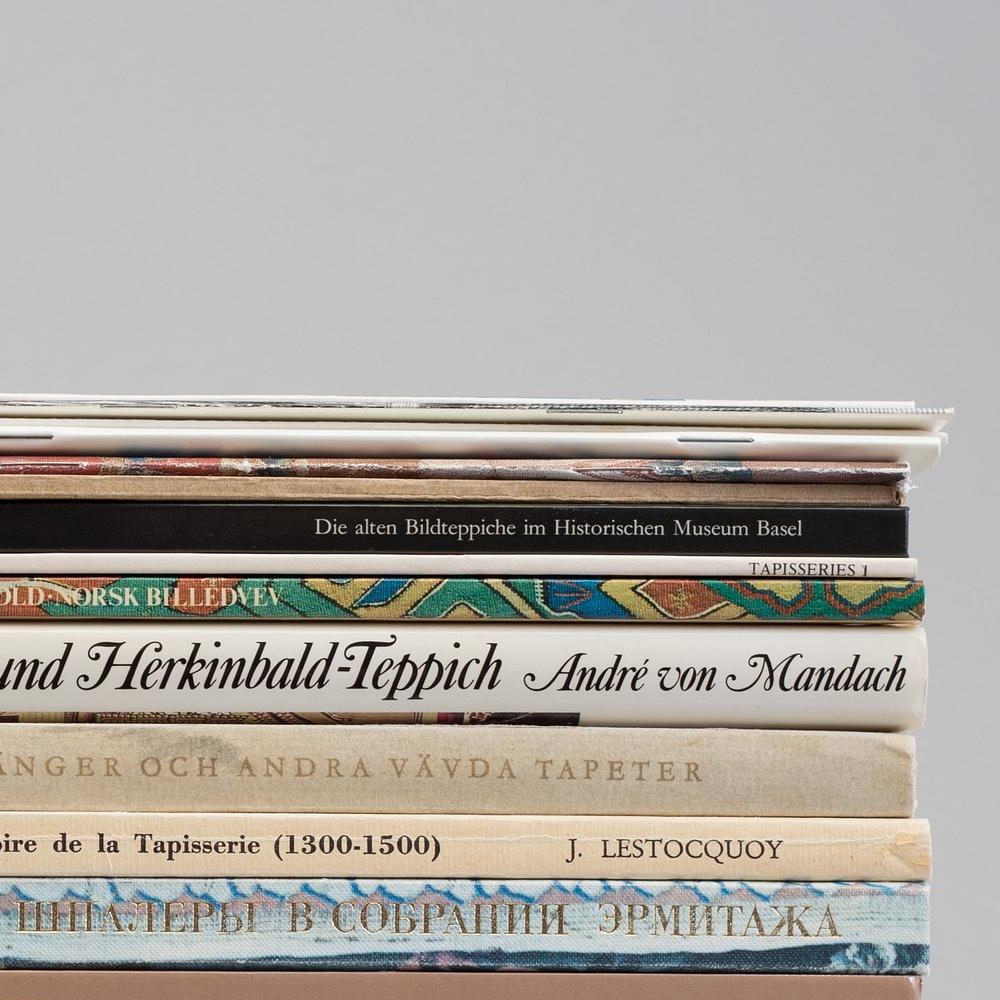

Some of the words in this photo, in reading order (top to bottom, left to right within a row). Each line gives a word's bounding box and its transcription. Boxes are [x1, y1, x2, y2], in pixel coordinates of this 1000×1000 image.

[315, 517, 346, 536] Die
[354, 518, 397, 537] alten
[404, 517, 516, 541] Bildteppiche
[523, 518, 546, 537] im
[554, 518, 664, 538] Historischen
[672, 519, 749, 538] Museum
[756, 518, 804, 538] Basel
[749, 562, 856, 577] TAPISSERIES
[147, 587, 285, 607] BILLEDVEV
[523, 653, 649, 694] André
[657, 668, 717, 692] von
[725, 653, 907, 694] Mandach
[139, 757, 219, 778] OCH
[235, 757, 372, 780] ANDRA
[388, 753, 519, 781] VÄVDA
[534, 759, 705, 783] TAPETER
[52, 831, 83, 855] de
[96, 831, 120, 855] la
[134, 832, 261, 861] Tapisserie
[273, 831, 442, 862] (1300-1500)
[566, 838, 582, 863] J.
[602, 838, 784, 863] LESTOCQUOY
[15, 900, 258, 934] ШПАЛЕРЫ
[288, 901, 314, 934] В
[331, 902, 570, 936] СОБРАНИИ
[598, 903, 842, 938] ЭРМИТАЖА
